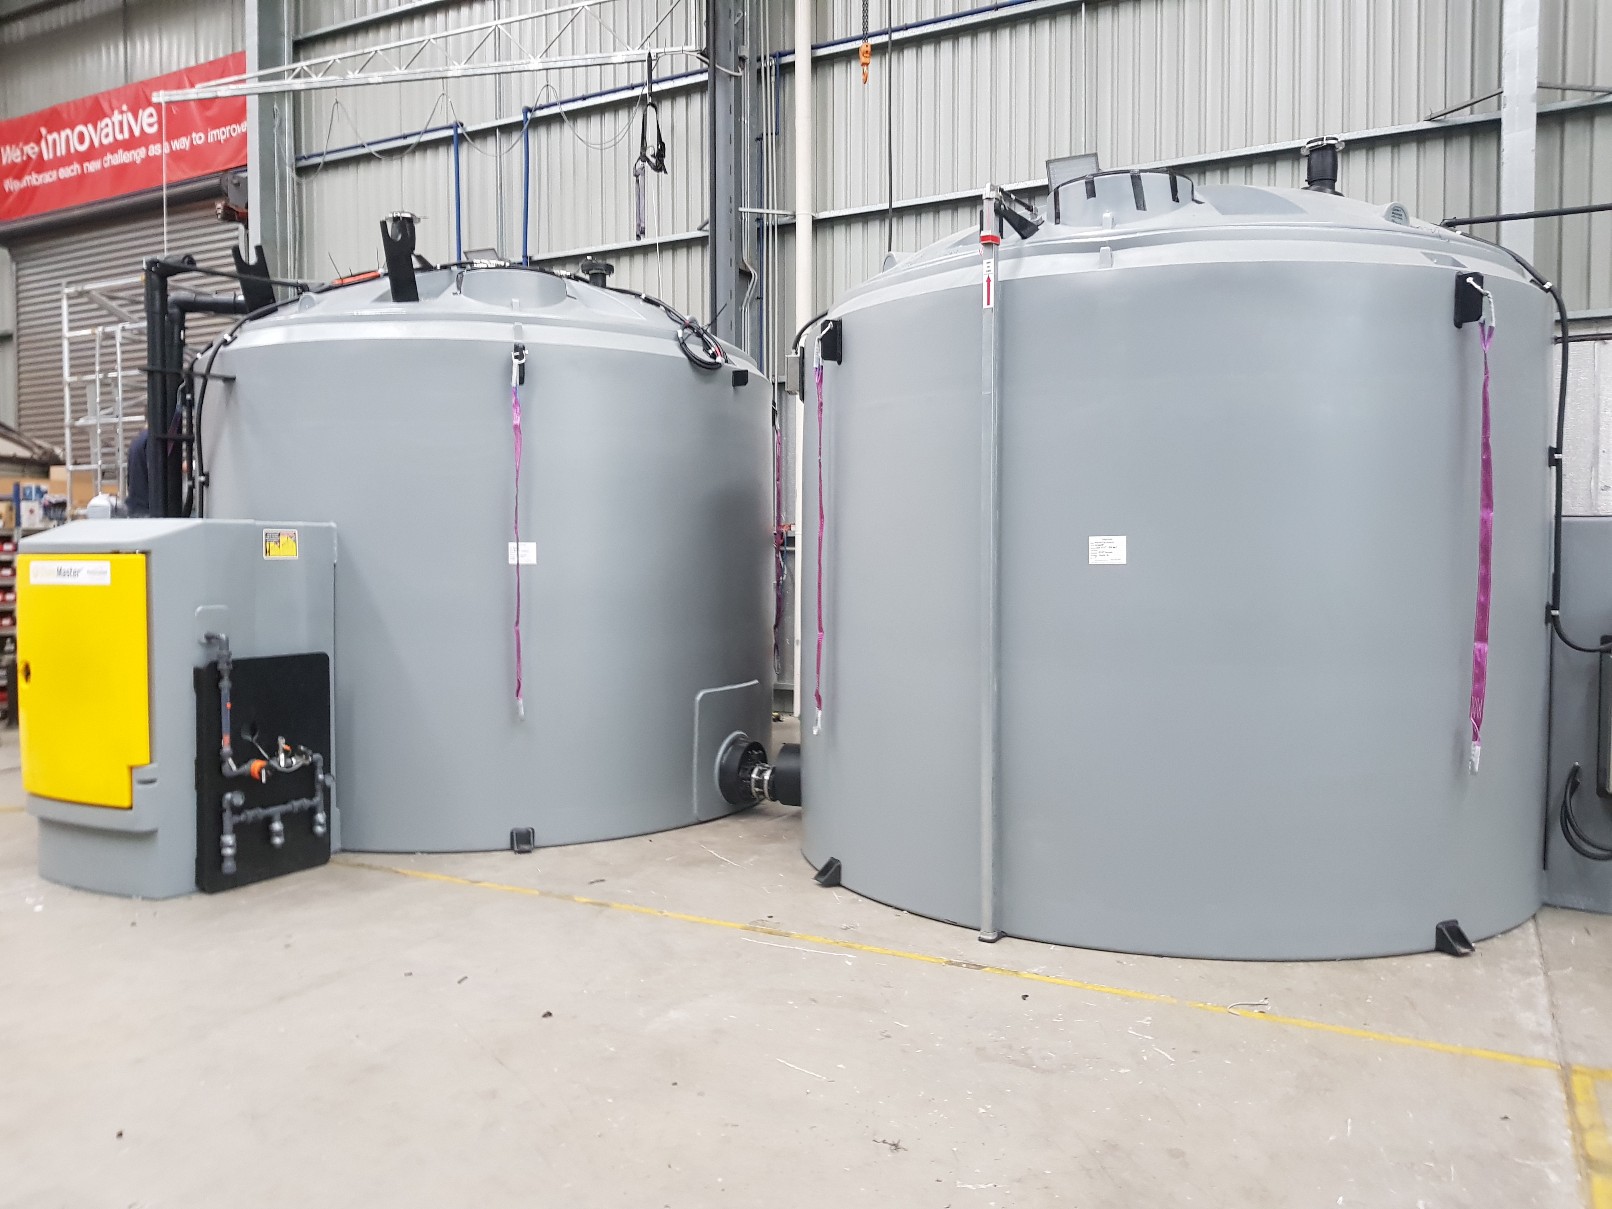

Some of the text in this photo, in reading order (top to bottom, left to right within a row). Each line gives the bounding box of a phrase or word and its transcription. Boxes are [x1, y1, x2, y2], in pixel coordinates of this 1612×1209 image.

[40, 104, 158, 160] innovative
[58, 161, 81, 179] each
[83, 158, 101, 174] new
[102, 146, 146, 168] challenge
[148, 142, 162, 156] as
[171, 134, 190, 150] way
[191, 131, 205, 145] to
